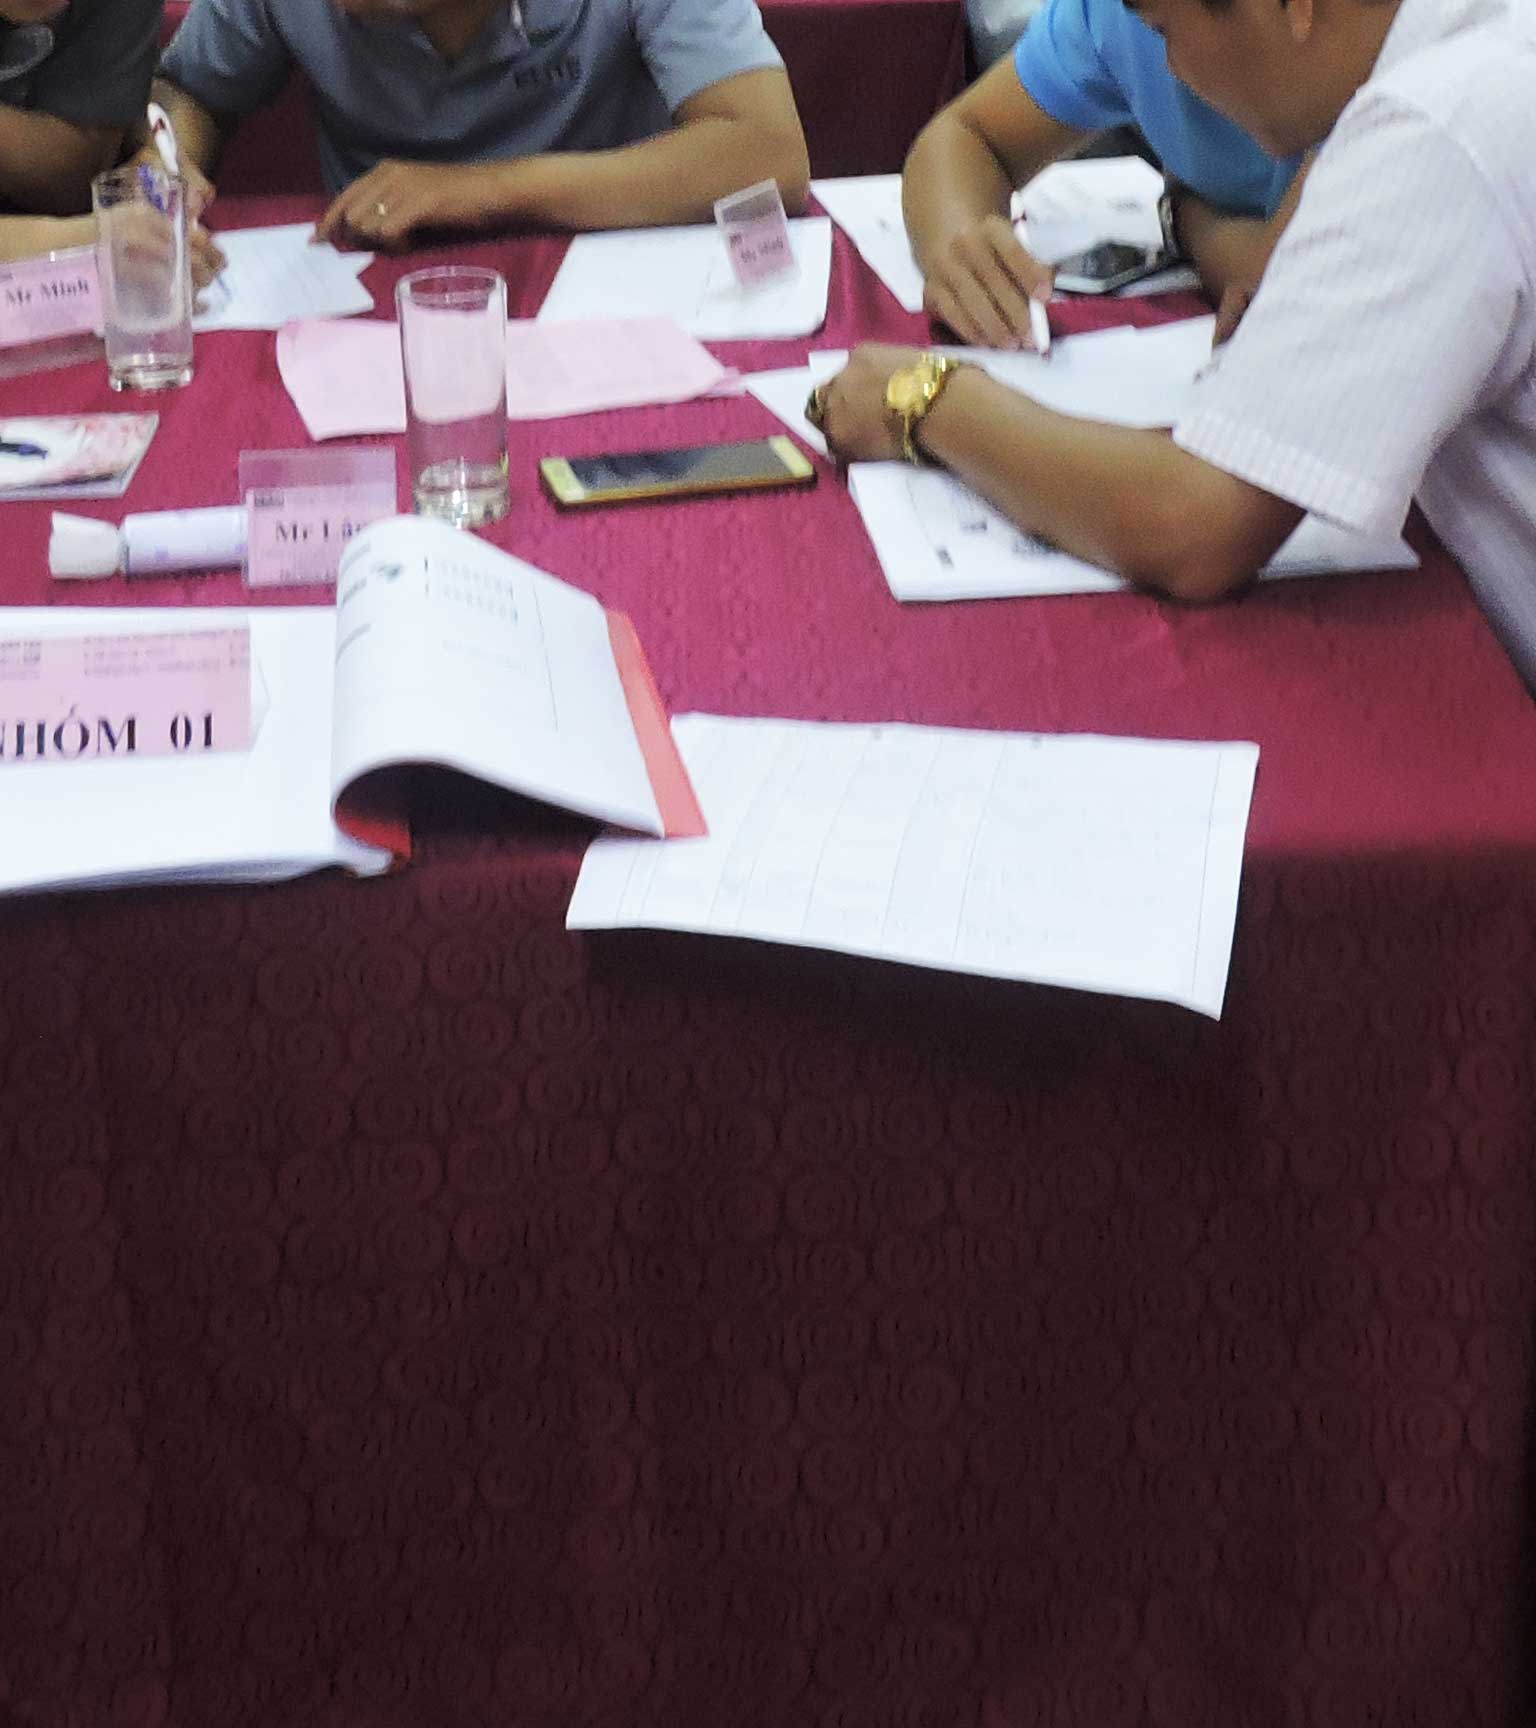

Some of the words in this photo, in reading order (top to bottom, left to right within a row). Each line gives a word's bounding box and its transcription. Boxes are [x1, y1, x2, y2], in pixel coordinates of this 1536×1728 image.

[5, 286, 32, 306] Mr
[275, 522, 310, 542] Mr
[168, 712, 214, 750] 01
